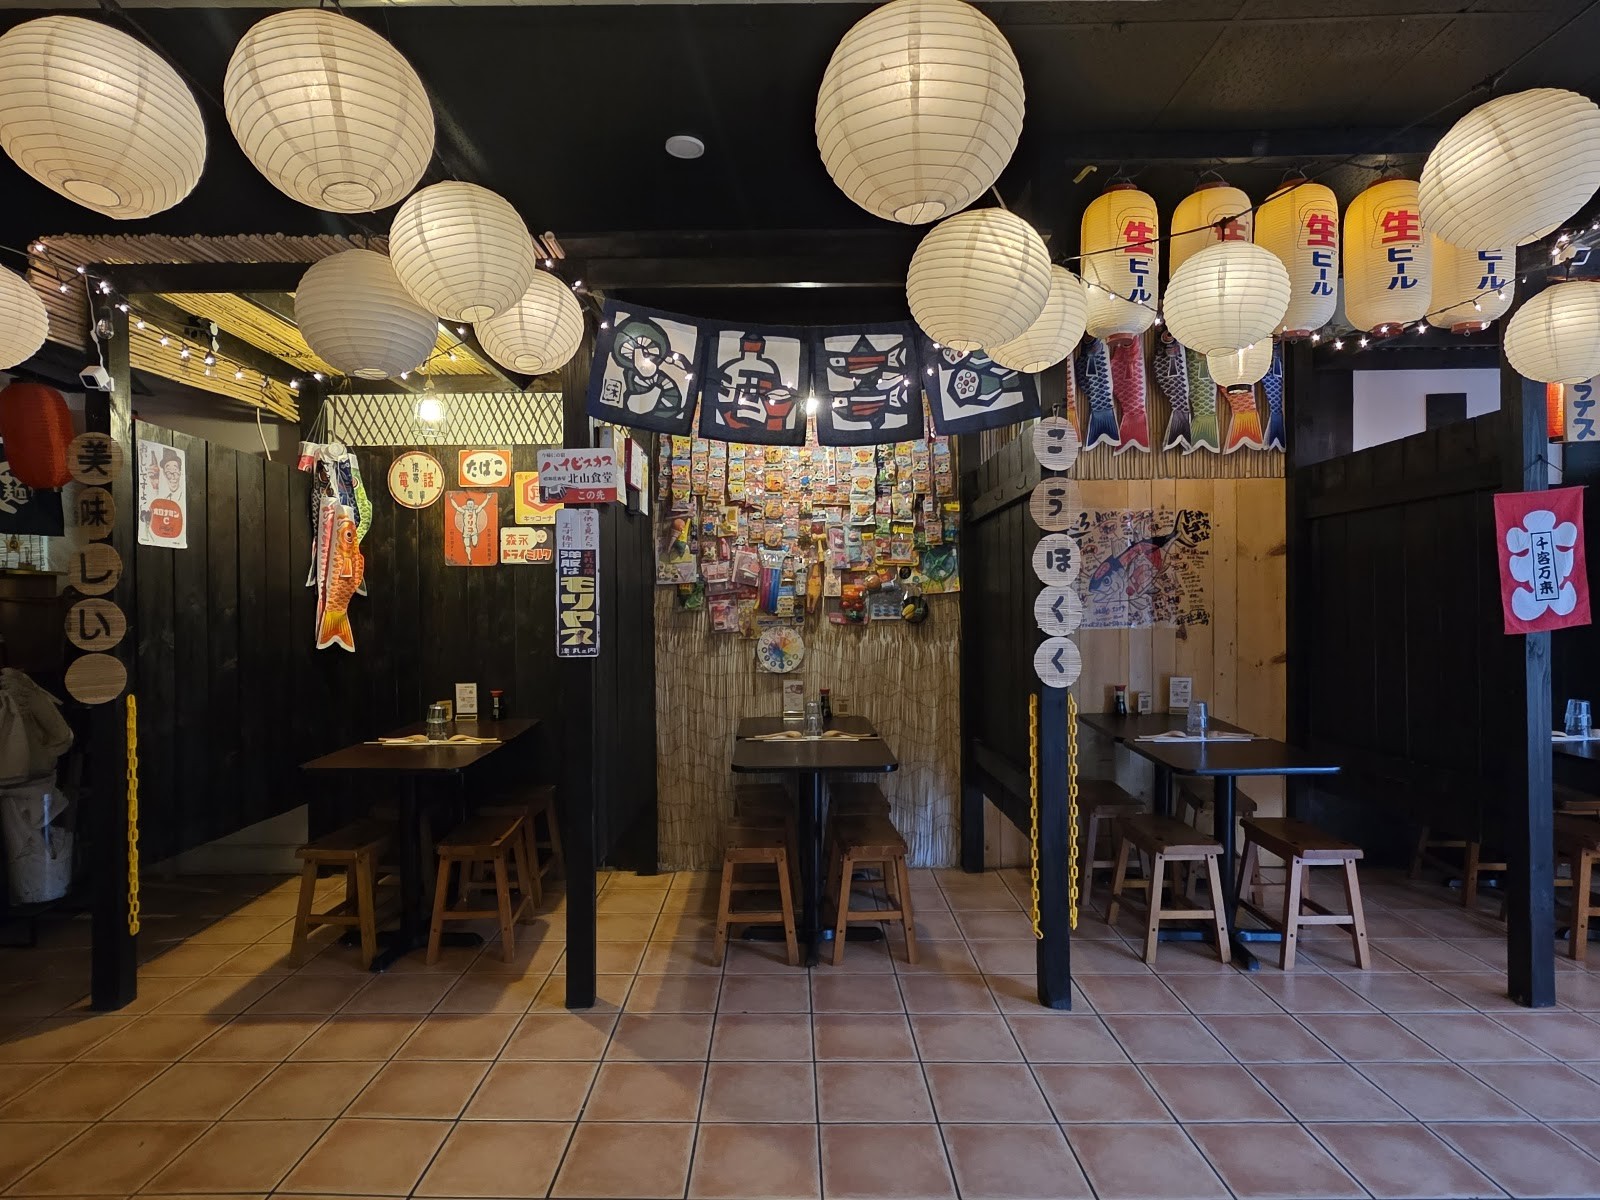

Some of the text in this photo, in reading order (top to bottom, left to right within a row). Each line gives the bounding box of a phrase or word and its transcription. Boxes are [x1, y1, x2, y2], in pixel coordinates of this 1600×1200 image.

[1123, 221, 1155, 302] 生ビール
[1306, 213, 1336, 296] 生ビール
[1379, 210, 1420, 290] 生ビール
[466, 458, 503, 478] たばこ
[541, 455, 613, 473] ハイビスカス
[567, 471, 613, 484] 北山食堂
[578, 490, 605, 500] この先
[76, 441, 113, 641] 美味しい
[503, 549, 551, 560] ドライミルク
[506, 534, 528, 545] 森永
[1536, 537, 1554, 594] 千客万来
[561, 577, 595, 645] モリヤス
